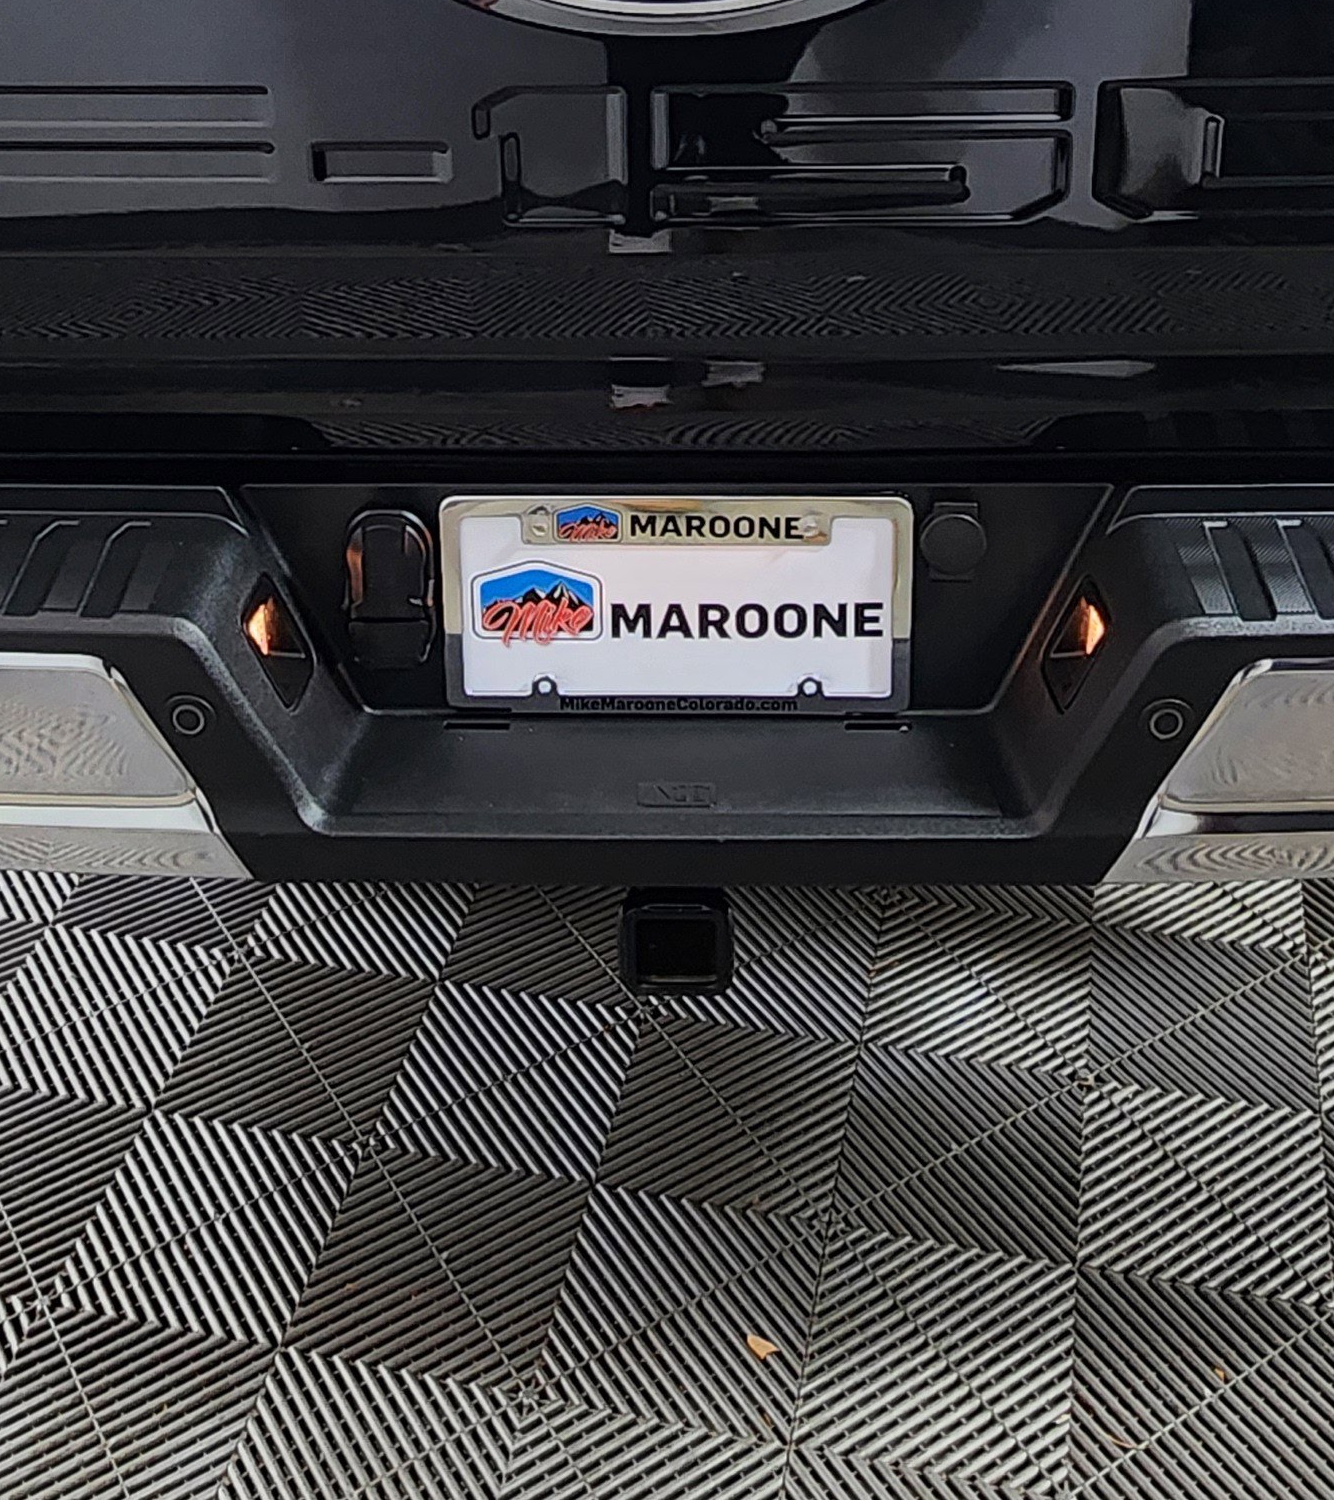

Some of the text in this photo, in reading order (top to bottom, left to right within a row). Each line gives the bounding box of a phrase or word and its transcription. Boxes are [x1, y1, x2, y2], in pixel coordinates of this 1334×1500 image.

[558, 514, 804, 542] Mike MAROONE
[481, 596, 885, 648] Mike MAROONE
[559, 698, 799, 711] MikeMarooneColorado.com
